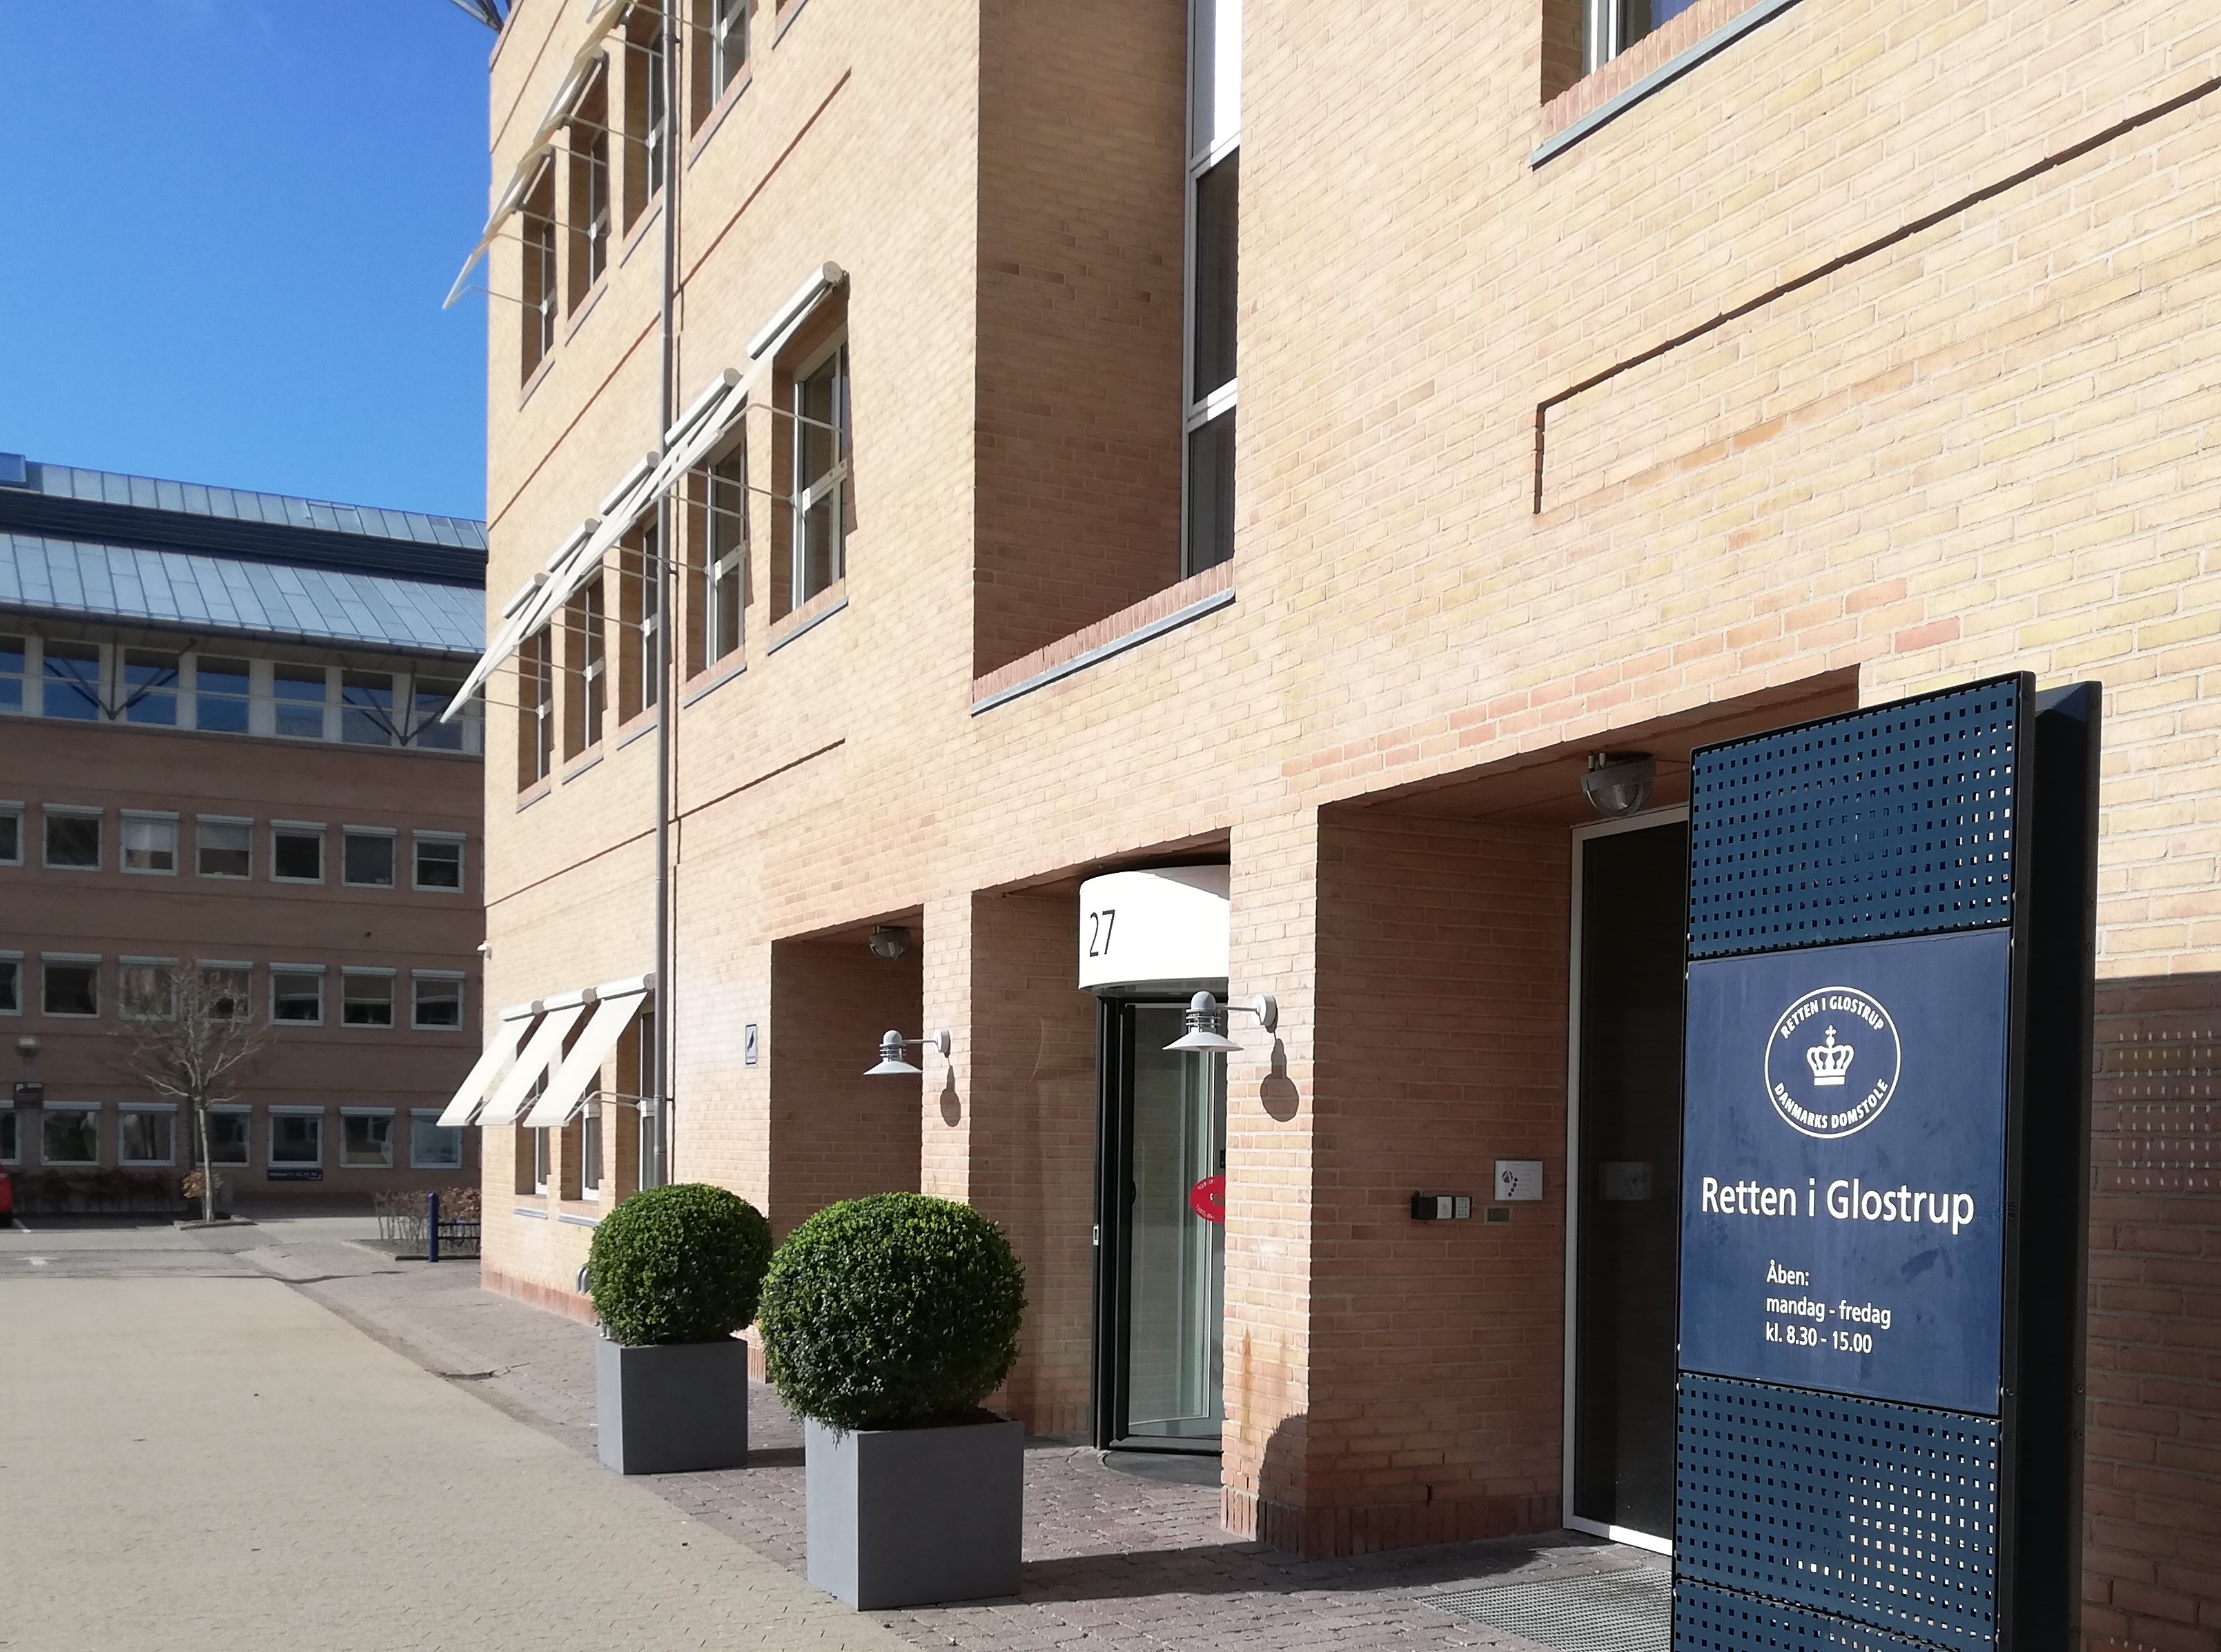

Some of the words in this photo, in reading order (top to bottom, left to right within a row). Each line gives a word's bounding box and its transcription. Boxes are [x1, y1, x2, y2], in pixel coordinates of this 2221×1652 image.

[1089, 909, 1115, 958] 27
[1780, 999, 1819, 1039] RETTEN
[1821, 997, 1826, 1011] I
[1829, 995, 1884, 1030] GLOSTRUP
[1774, 1082, 1828, 1129] DANMARKS
[1831, 1078, 1888, 1129] DOMSTOLE
[1702, 1177, 1797, 1217] Retten
[1808, 1177, 1815, 1217] i
[1826, 1178, 1974, 1235] Glostrup
[1766, 1259, 1810, 1286] Åben:
[1766, 1295, 1826, 1323] mandag
[1838, 1299, 1891, 1330] fredag
[1765, 1321, 1783, 1343] kl.
[1786, 1325, 1817, 1347] 8.30
[1832, 1330, 1872, 1354] 15.00
